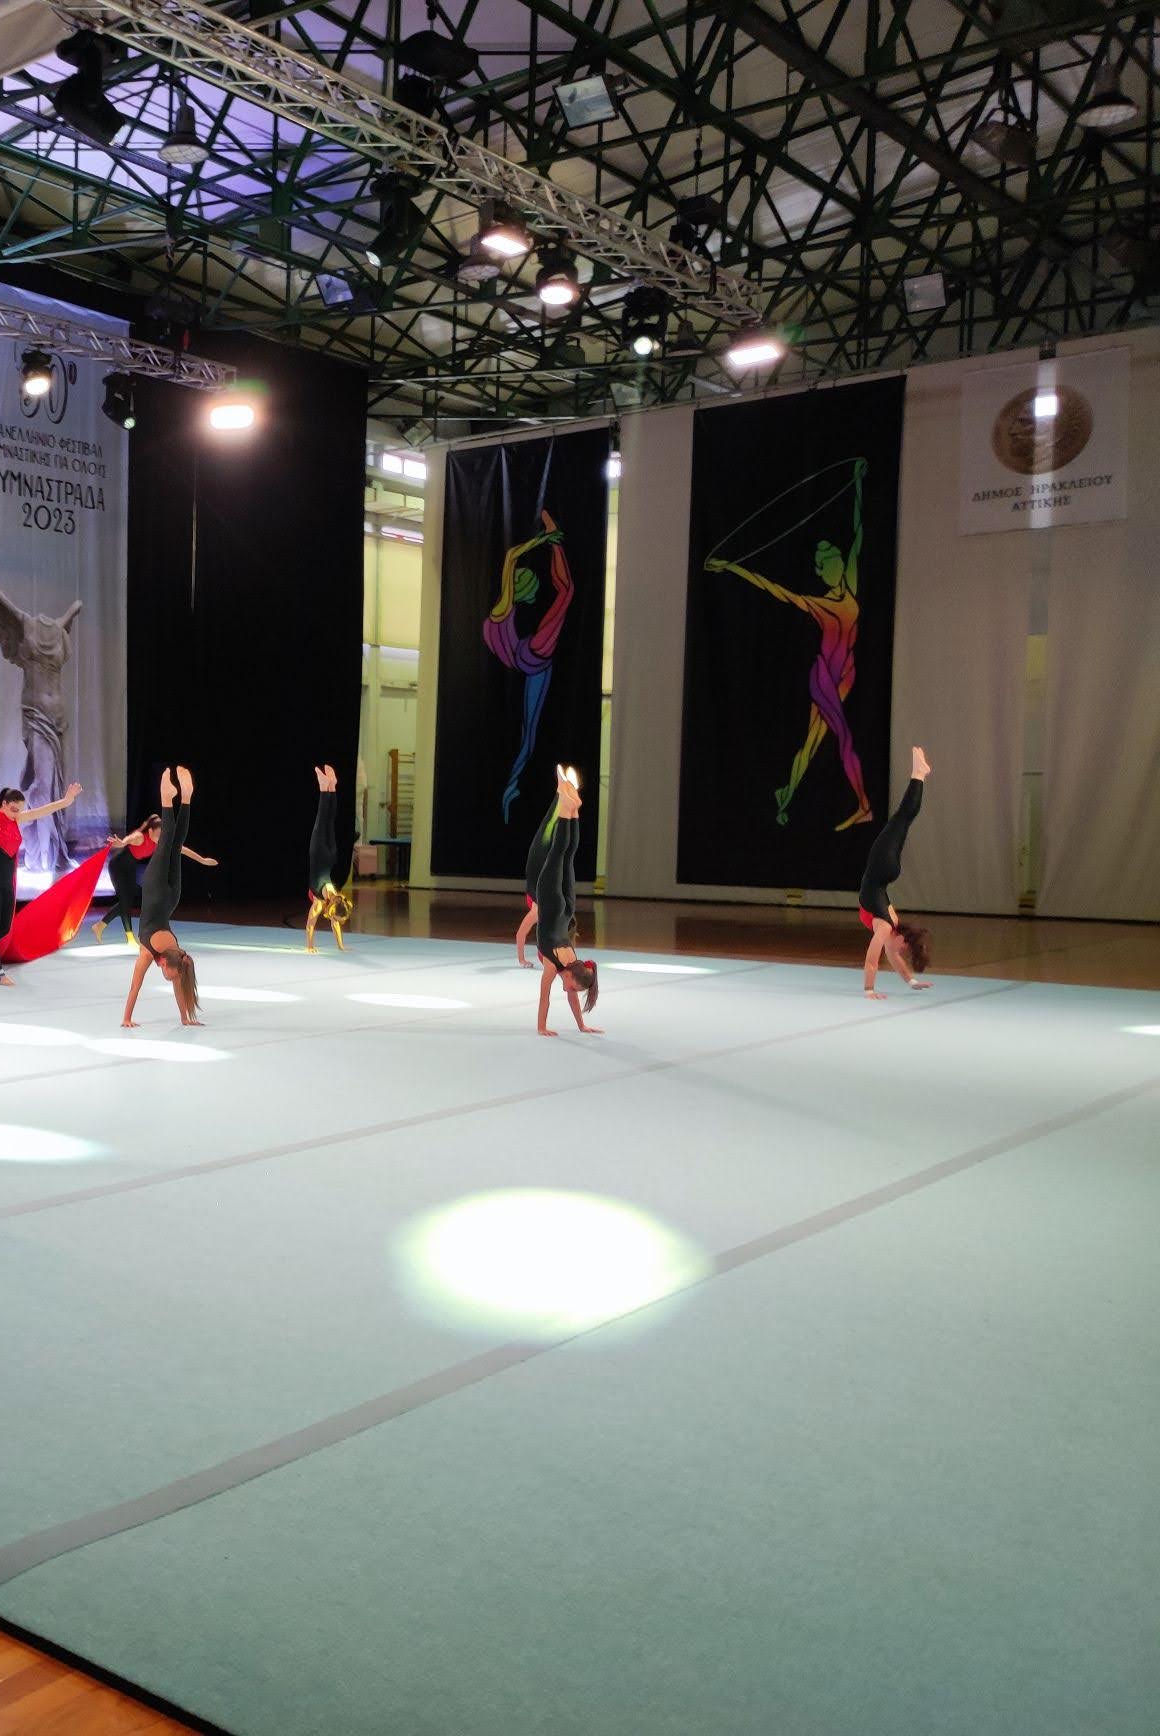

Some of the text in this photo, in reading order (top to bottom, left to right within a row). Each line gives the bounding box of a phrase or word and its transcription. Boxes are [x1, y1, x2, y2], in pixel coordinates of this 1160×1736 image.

[971, 475, 1113, 503] ΔΗΜΟΣ ΗΡΑΚΛΕΙΟΥ
[21, 501, 76, 535] 2023
[1011, 495, 1072, 513] ΑΤΤΙΚΗΣ
